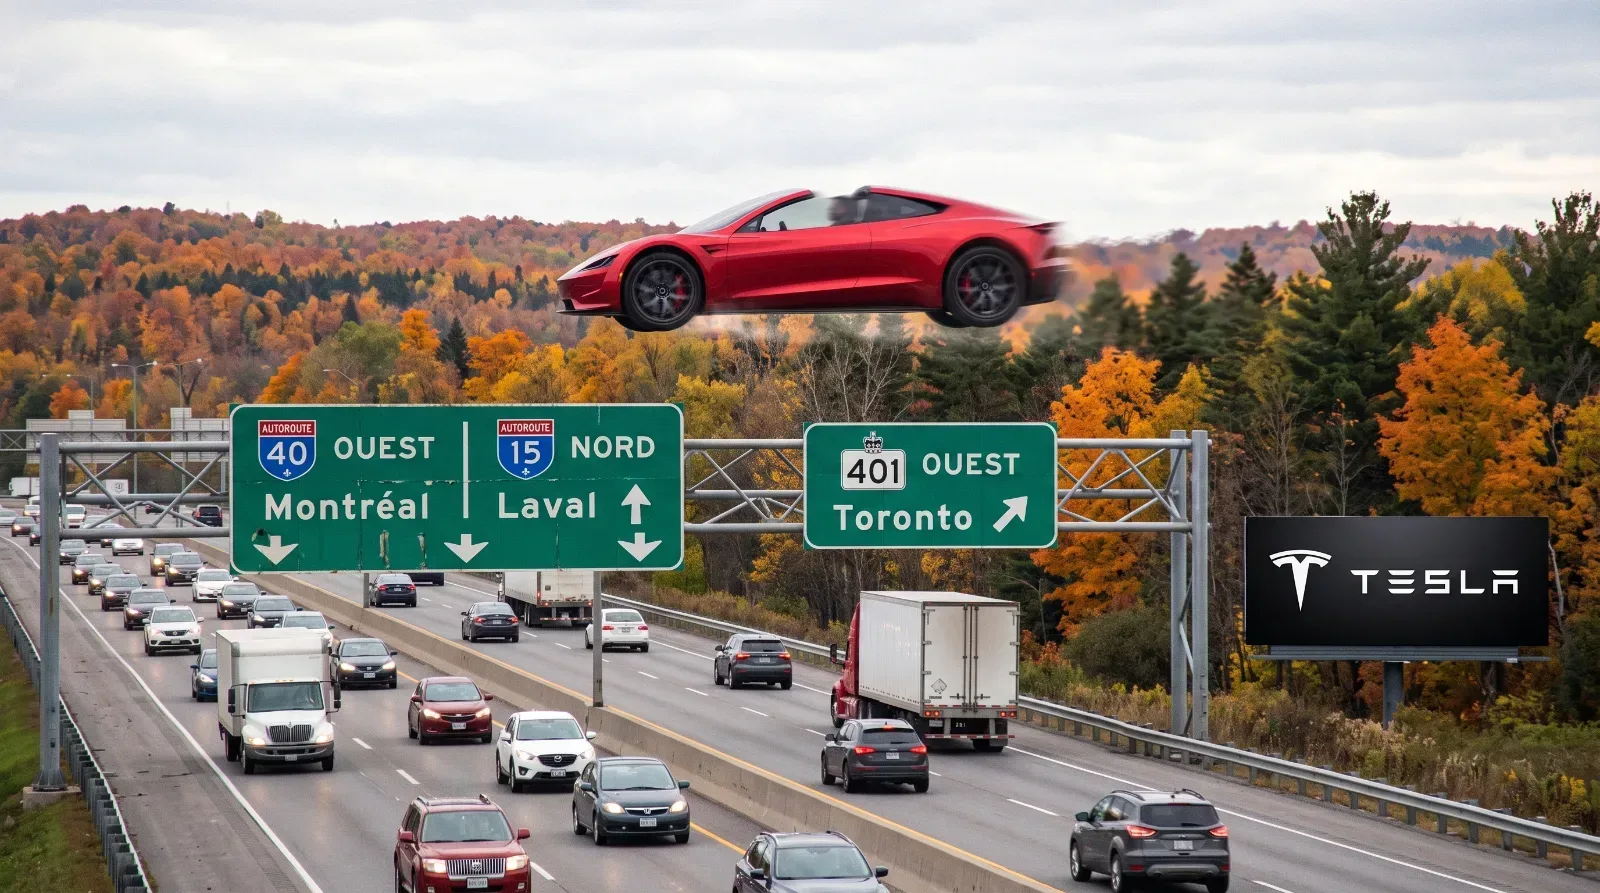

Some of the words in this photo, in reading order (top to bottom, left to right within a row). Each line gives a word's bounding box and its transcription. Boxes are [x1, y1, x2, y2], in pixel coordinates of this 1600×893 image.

[262, 424, 312, 433] AUTOROUTE
[501, 423, 550, 432] AUTOROUTE
[266, 441, 307, 465] 40
[334, 436, 435, 459] OUEST
[511, 440, 541, 465] 15
[571, 435, 655, 459] NORD
[847, 458, 899, 484] 401
[922, 452, 1020, 475] OUEST
[265, 490, 428, 520] Montréal
[498, 491, 596, 519] Laval
[833, 503, 973, 531] Toronto
[1350, 569, 1519, 594] TESLA
